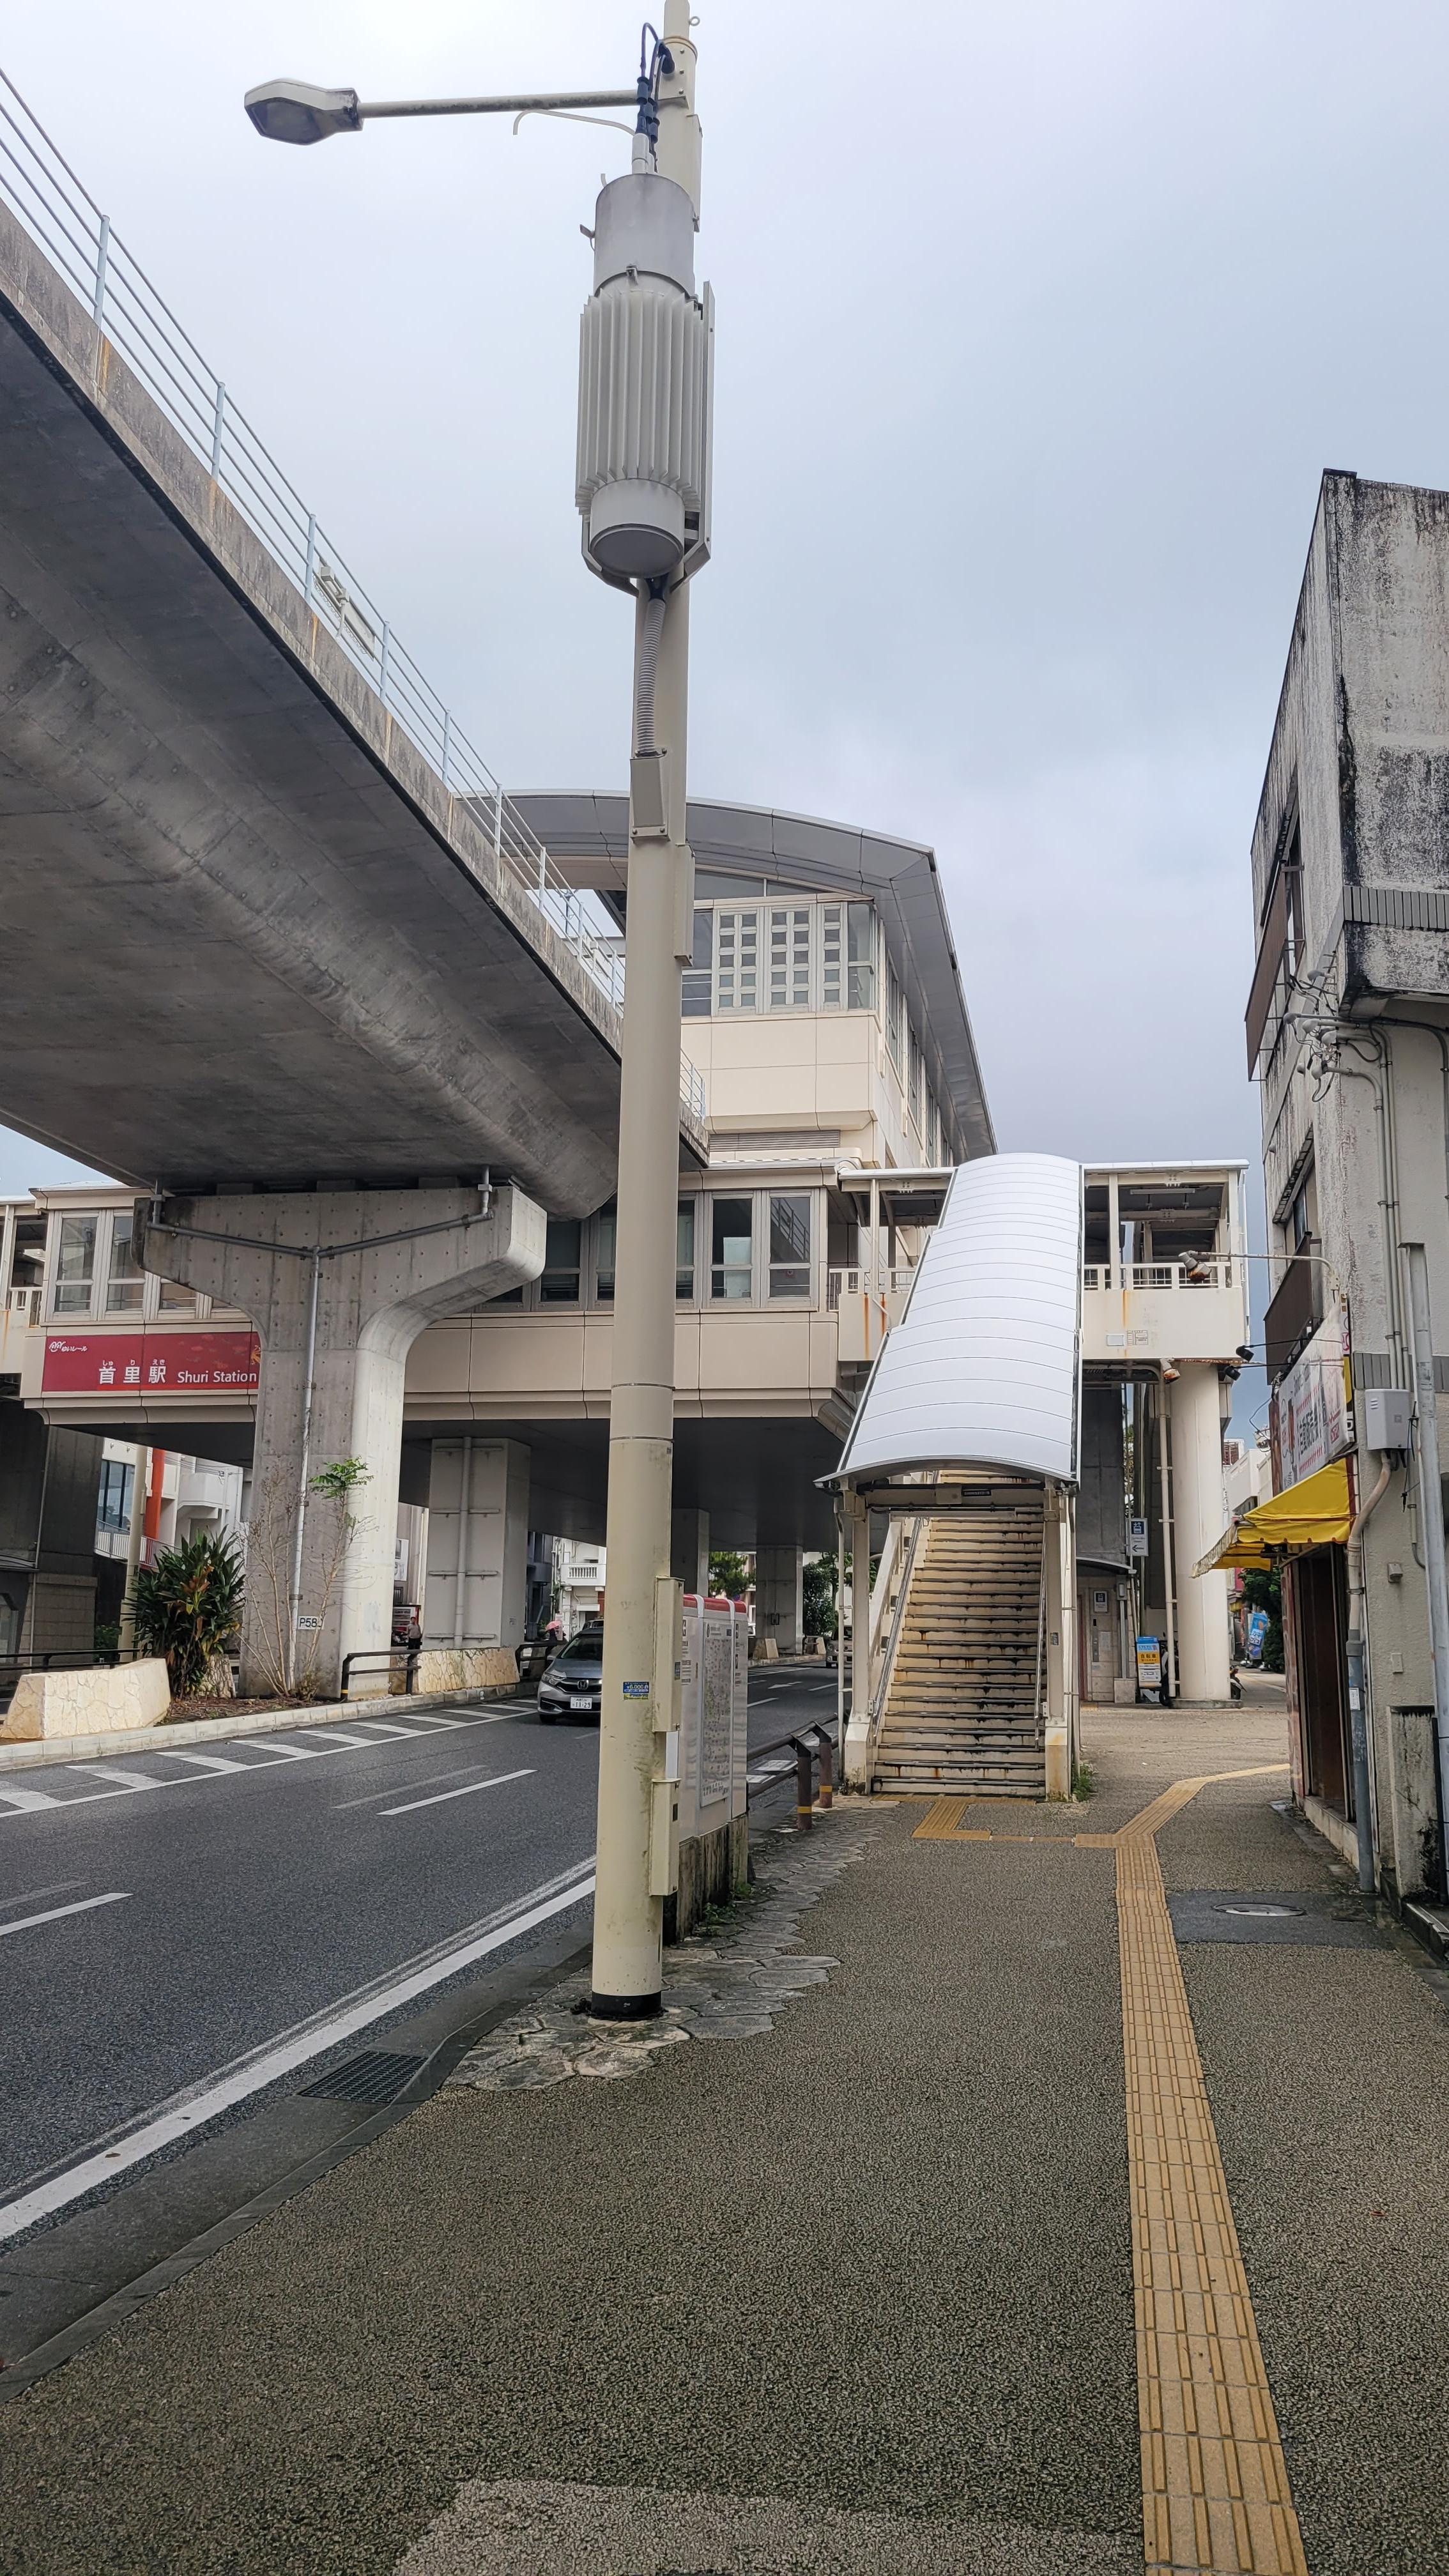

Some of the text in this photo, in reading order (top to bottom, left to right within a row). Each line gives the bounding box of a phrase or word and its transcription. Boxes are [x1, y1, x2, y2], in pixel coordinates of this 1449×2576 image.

[99, 1366, 166, 1384] 首里駅
[177, 1370, 257, 1383] Shuri Station
